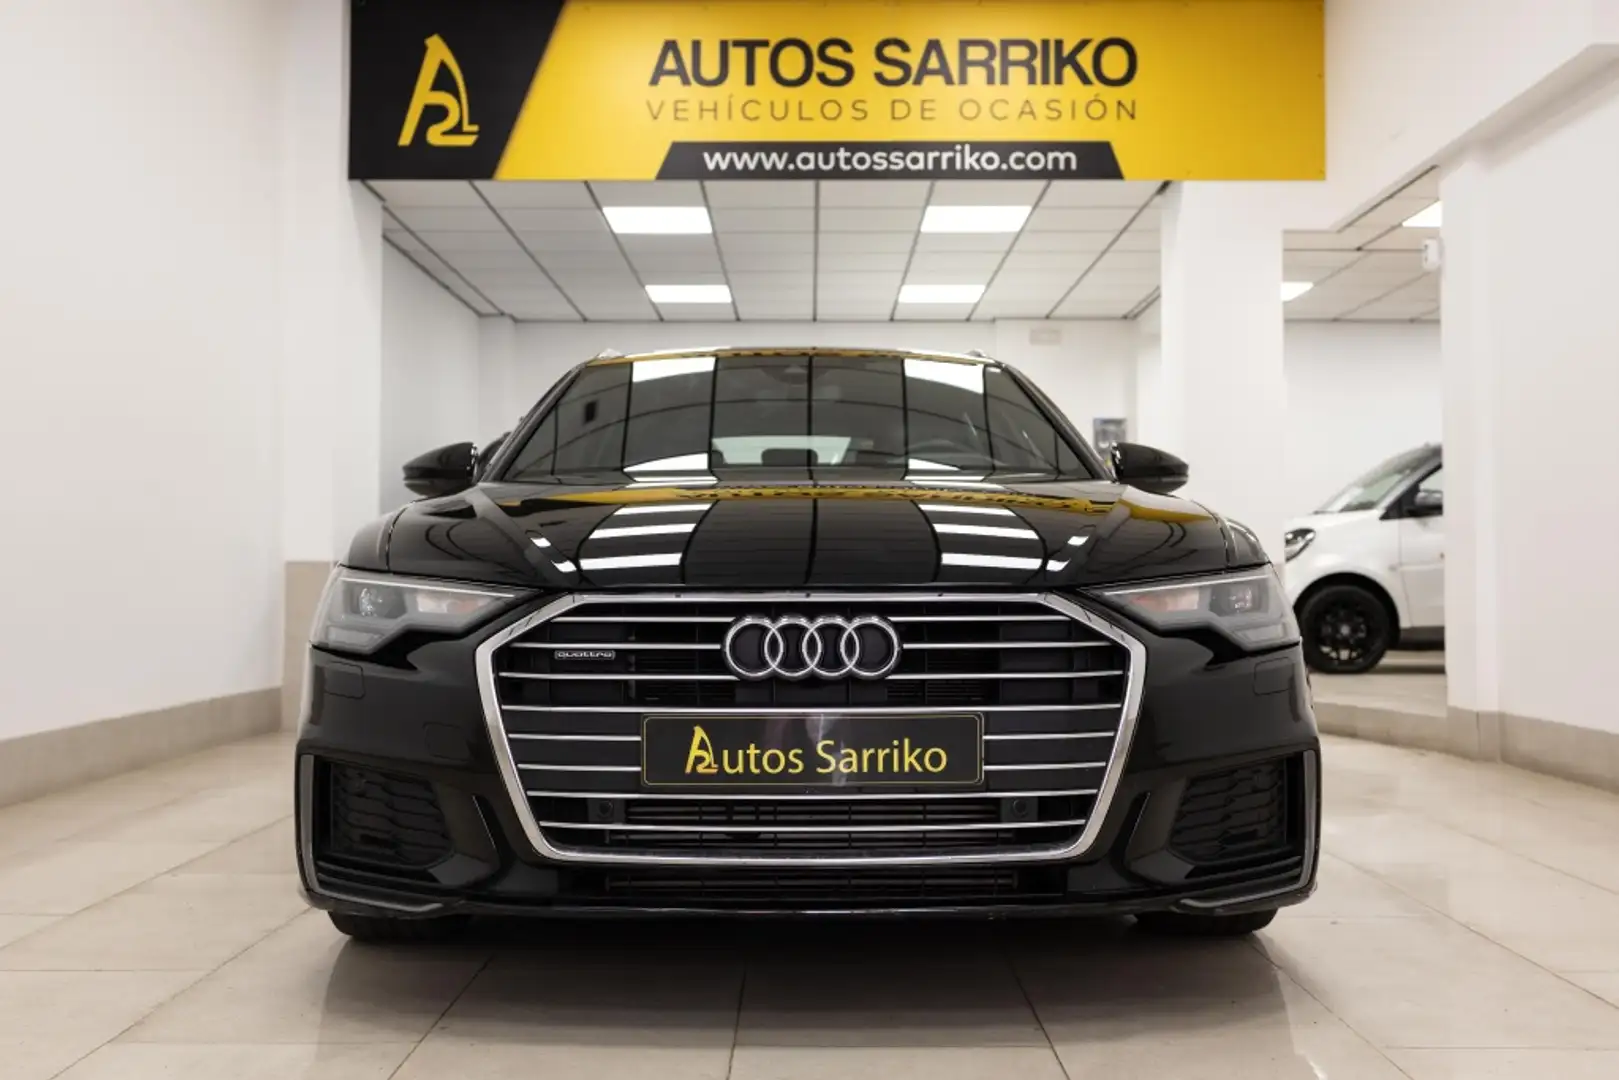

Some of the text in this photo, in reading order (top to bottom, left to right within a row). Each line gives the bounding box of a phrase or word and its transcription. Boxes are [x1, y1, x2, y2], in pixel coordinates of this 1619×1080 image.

[649, 37, 1138, 87] AUTOS SARRIKO
[646, 94, 1137, 122] VEHÍCULOS DE OCASIÓN
[703, 143, 1078, 172] www.autossarriko.com
[557, 650, 613, 660] quattro
[684, 725, 948, 775] Autos Sarriko
